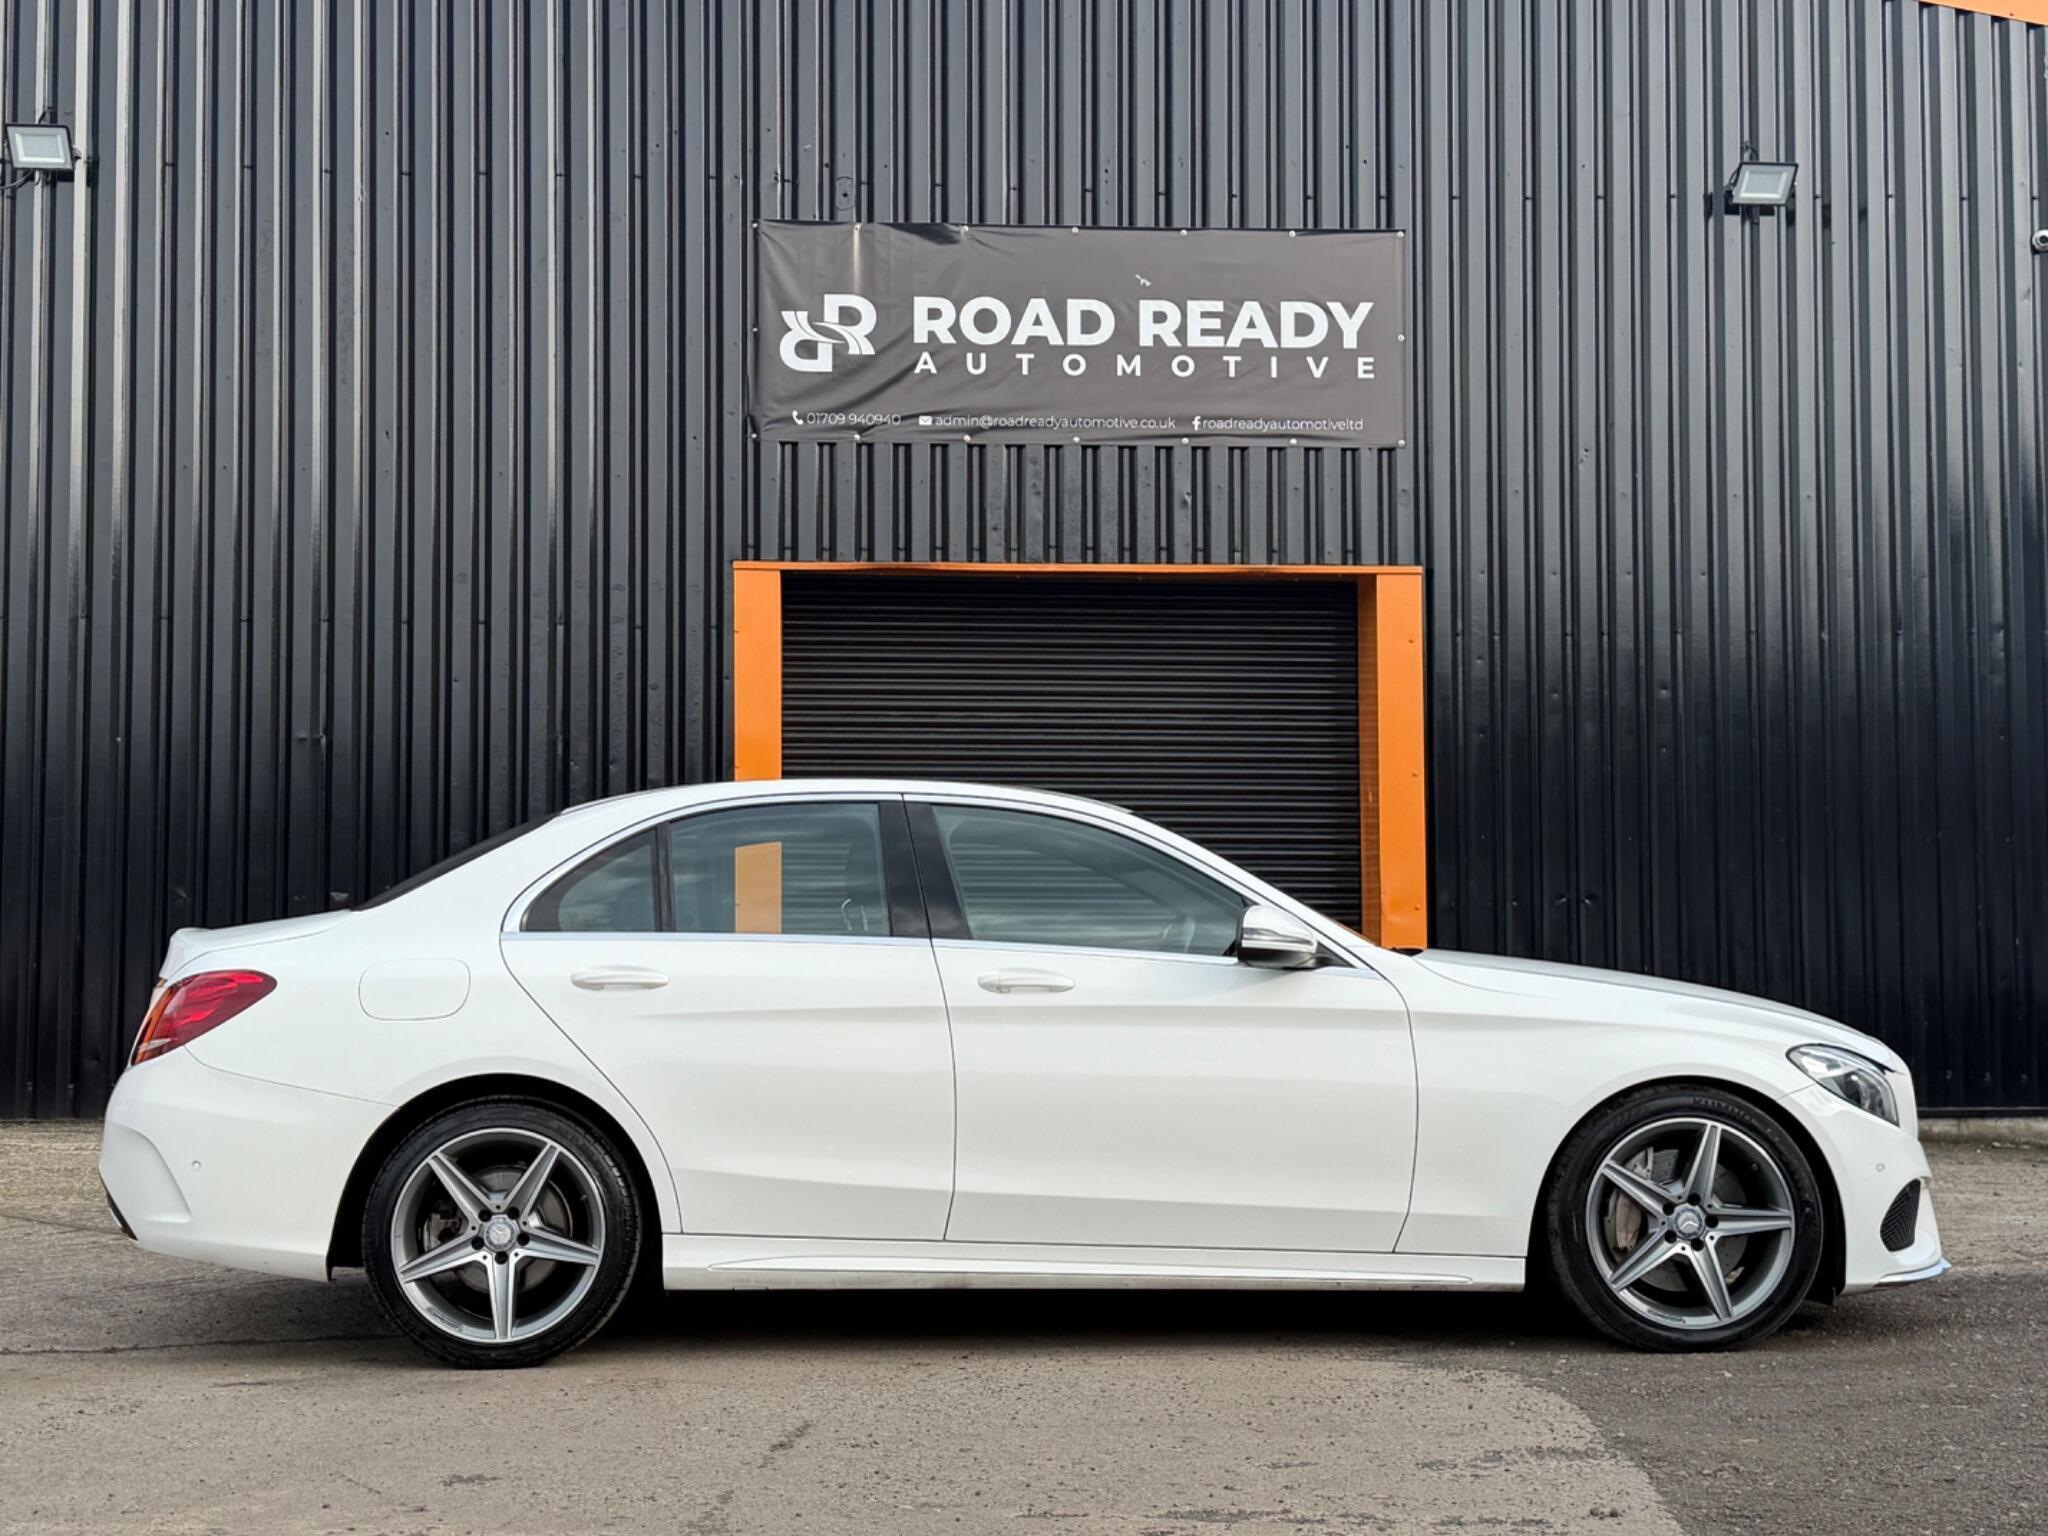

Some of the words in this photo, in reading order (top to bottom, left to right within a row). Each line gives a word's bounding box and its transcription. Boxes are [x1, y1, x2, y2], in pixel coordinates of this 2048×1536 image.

[912, 296, 1116, 346] ROAD
[1138, 299, 1375, 350] READY
[913, 351, 1376, 379] AUTOMOTIVE
[806, 411, 846, 425] 01709
[848, 412, 902, 426] 940940
[935, 413, 1176, 431] admin@roadreadyautomotive.co.uk
[1202, 418, 1364, 433] roadreadyautomotiveltd
